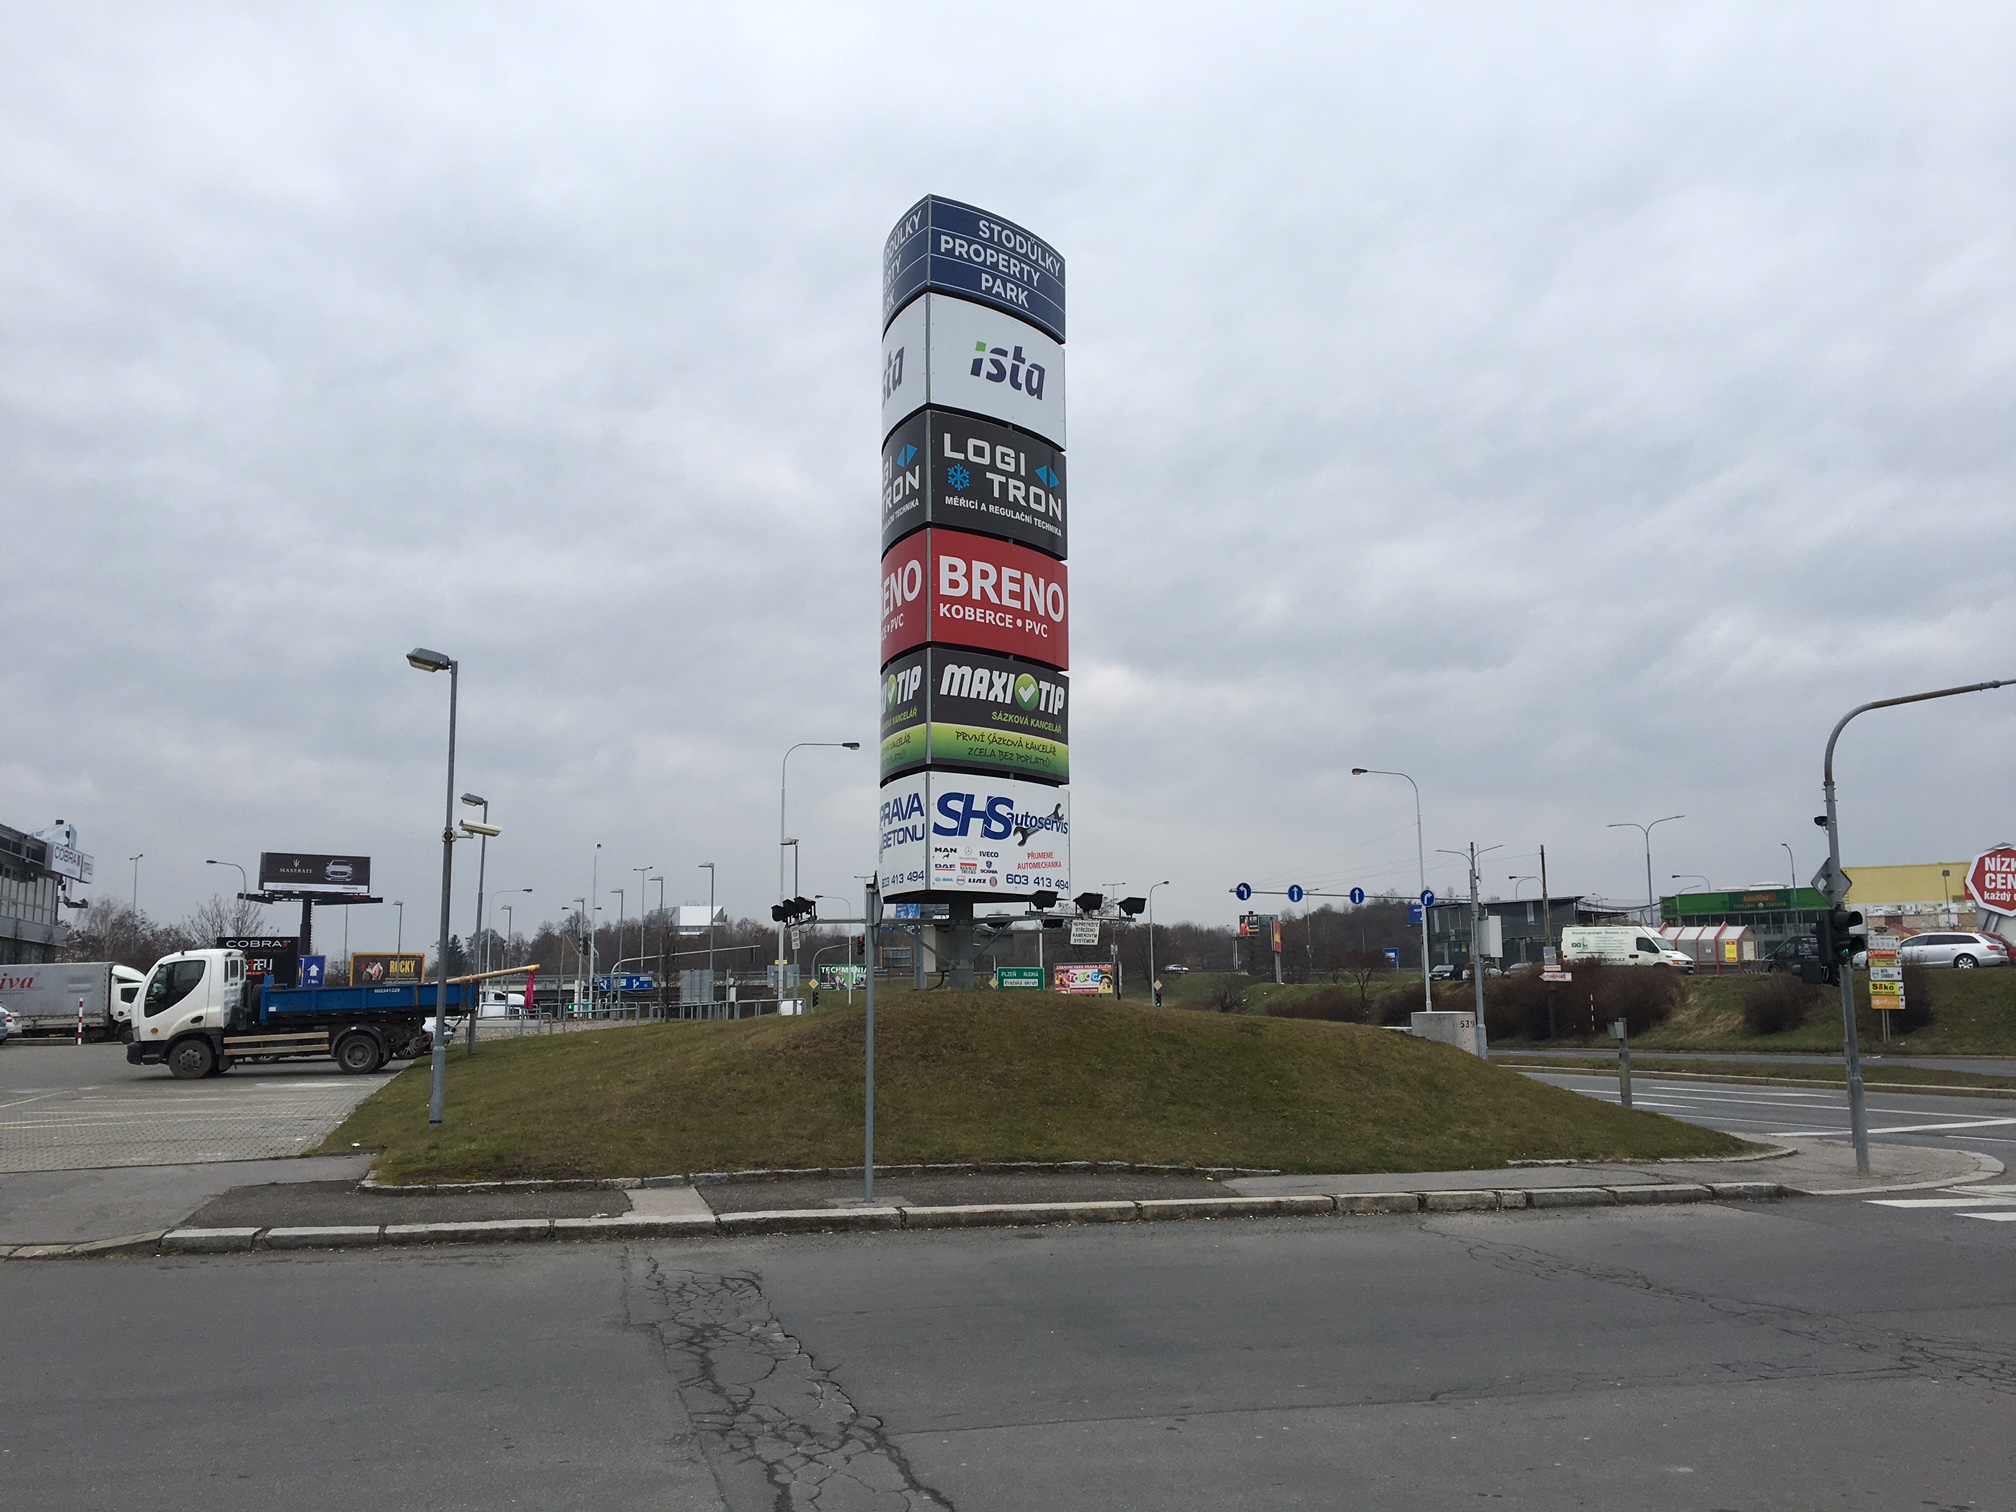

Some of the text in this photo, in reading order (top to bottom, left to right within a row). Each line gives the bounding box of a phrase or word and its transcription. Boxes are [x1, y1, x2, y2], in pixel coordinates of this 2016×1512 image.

[940, 235, 1040, 287] PROPERTY
[978, 219, 1061, 277] STODŮLKY
[981, 273, 1029, 308] PARK
[970, 341, 1045, 400] ista
[943, 433, 1025, 476] LOGI
[985, 472, 1062, 522] TRON
[945, 496, 1062, 537] MĚŘICÍ A REGULAČNÍ TECHNIKA
[882, 559, 922, 621] ENO
[939, 555, 1065, 623] BRENO
[890, 613, 904, 633] PVC
[940, 603, 1048, 638] KOBERCE PVC
[897, 665, 922, 705] TIP
[940, 664, 1065, 716] MAXI TIP
[956, 730, 985, 743] PRVNÍ
[991, 710, 1062, 735] SÁZKOVÁ KANCELÁŘ
[999, 749, 1013, 762] BEZ
[932, 792, 1014, 841] SHS
[1006, 810, 1068, 836] autoservis
[979, 850, 999, 858] IVECO
[891, 873, 904, 886] 413
[907, 870, 924, 883] 494
[1005, 873, 1029, 886] 603
[1033, 876, 1052, 888] 413
[1055, 879, 1069, 890] 494
[1984, 891, 2011, 902] každý
[226, 940, 282, 948] COBRA
[1460, 1020, 1475, 1029] 539
